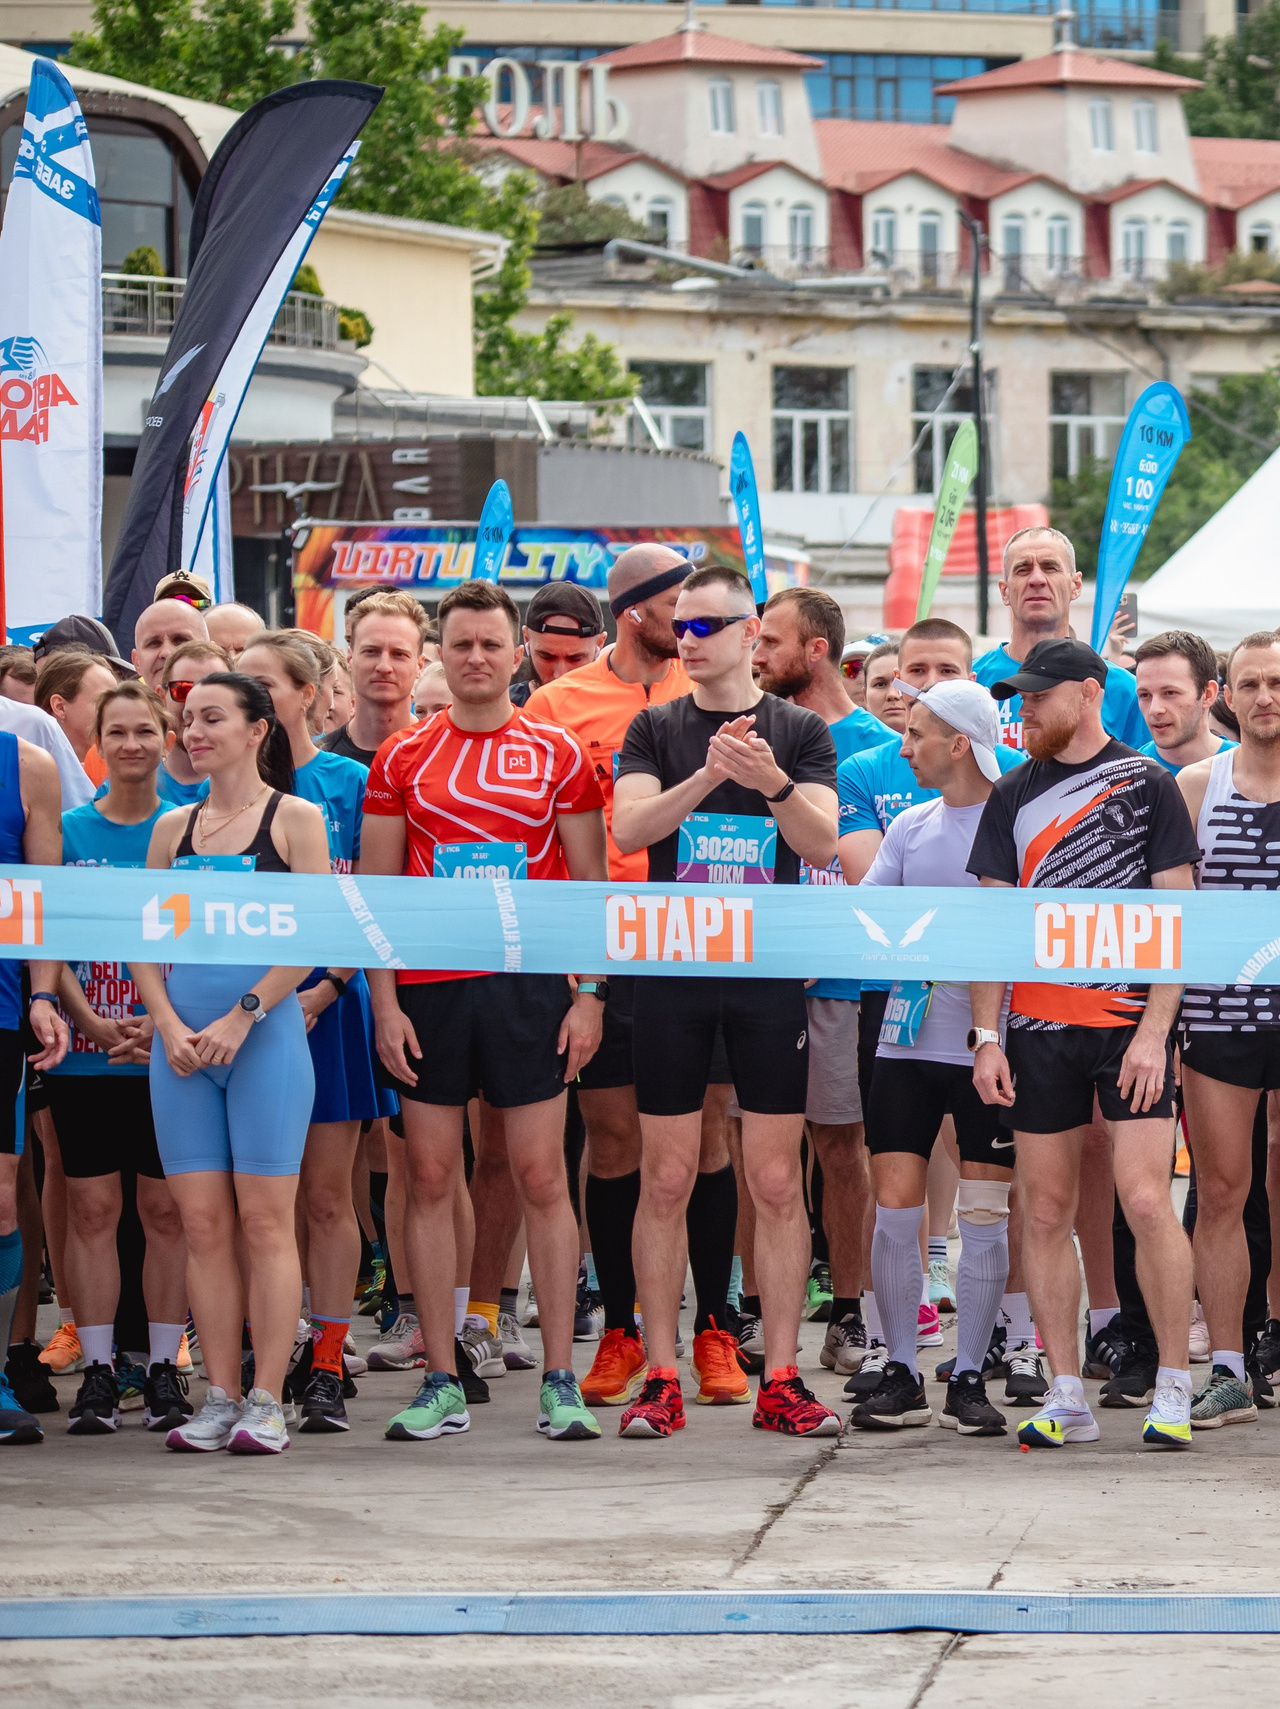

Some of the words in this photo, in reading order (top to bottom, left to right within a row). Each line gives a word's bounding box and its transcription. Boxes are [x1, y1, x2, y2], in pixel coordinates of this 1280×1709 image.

[448, 56, 630, 142] ОЛЬ
[1140, 424, 1153, 443] 10
[331, 541, 604, 581] VIRTULITY
[508, 754, 527, 769] pt
[695, 835, 759, 863] 30205
[204, 901, 298, 937] ПСБ
[605, 894, 753, 962] СТАРТ
[1034, 902, 1182, 969] СТАРТ
[861, 953, 888, 961] ЛИГА
[890, 953, 930, 962] ГЕРОЕВ
[884, 996, 912, 1023] 0151
